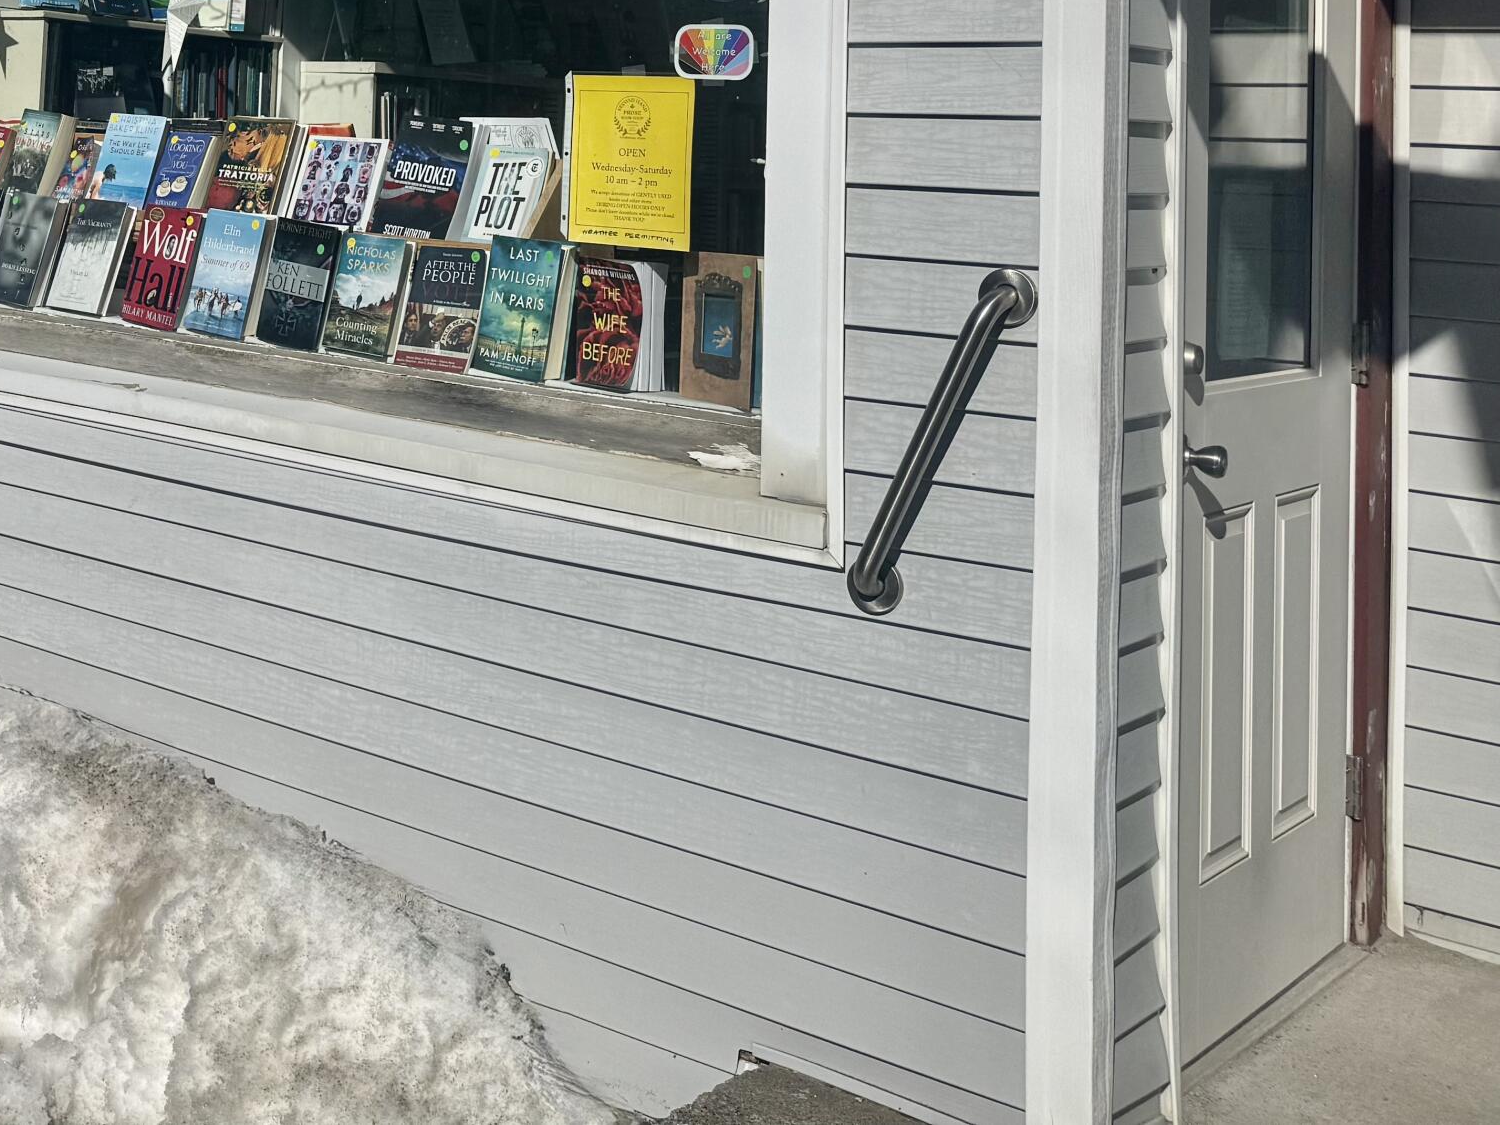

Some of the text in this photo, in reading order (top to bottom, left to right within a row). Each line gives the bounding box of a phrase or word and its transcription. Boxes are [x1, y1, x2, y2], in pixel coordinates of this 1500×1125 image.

[715, 33, 732, 41] are
[692, 47, 737, 57] Welcome
[701, 63, 725, 72] Here
[109, 139, 121, 147] THE
[122, 140, 137, 148] WAY
[110, 146, 135, 156] SHOULD
[169, 143, 203, 153] LOOKING
[618, 148, 647, 158] OPEN
[172, 160, 189, 170] YOU
[222, 163, 251, 171] PATRICIA
[591, 161, 673, 178] Wednesday-Saturday
[218, 169, 274, 182] TRATTORIA
[393, 160, 457, 187] PROVOKED
[488, 161, 528, 196] THE
[605, 175, 658, 189] 10 am 2 pm
[473, 195, 527, 231] PLOT
[223, 224, 242, 238] Elin
[383, 223, 431, 240] SCOTT HORTON
[142, 219, 198, 264] Wolf
[203, 236, 256, 256] Hilderbrand
[346, 246, 397, 261] NICHOLAS
[509, 246, 540, 263] LAST
[200, 254, 229, 268] Summer
[230, 259, 240, 273] of
[277, 261, 300, 277] KEN
[347, 258, 390, 274] SPARKS
[424, 259, 456, 272] AFTER
[456, 261, 477, 273] THE
[422, 268, 476, 286] PEOPLE
[491, 267, 552, 288] TWILIGHT
[610, 270, 636, 281] WILLIAMS
[124, 256, 187, 314] Hall
[266, 273, 324, 300] FOLLETT
[490, 290, 504, 305] IN
[509, 293, 545, 312] PARIS
[602, 286, 622, 302] THE
[121, 303, 174, 327] HILARY MANTEL
[593, 312, 629, 334] WIFE
[335, 317, 379, 335] Counting
[334, 329, 373, 345] Miracles
[479, 347, 537, 367] PAM JENOFF
[582, 341, 634, 366] BEFORE
